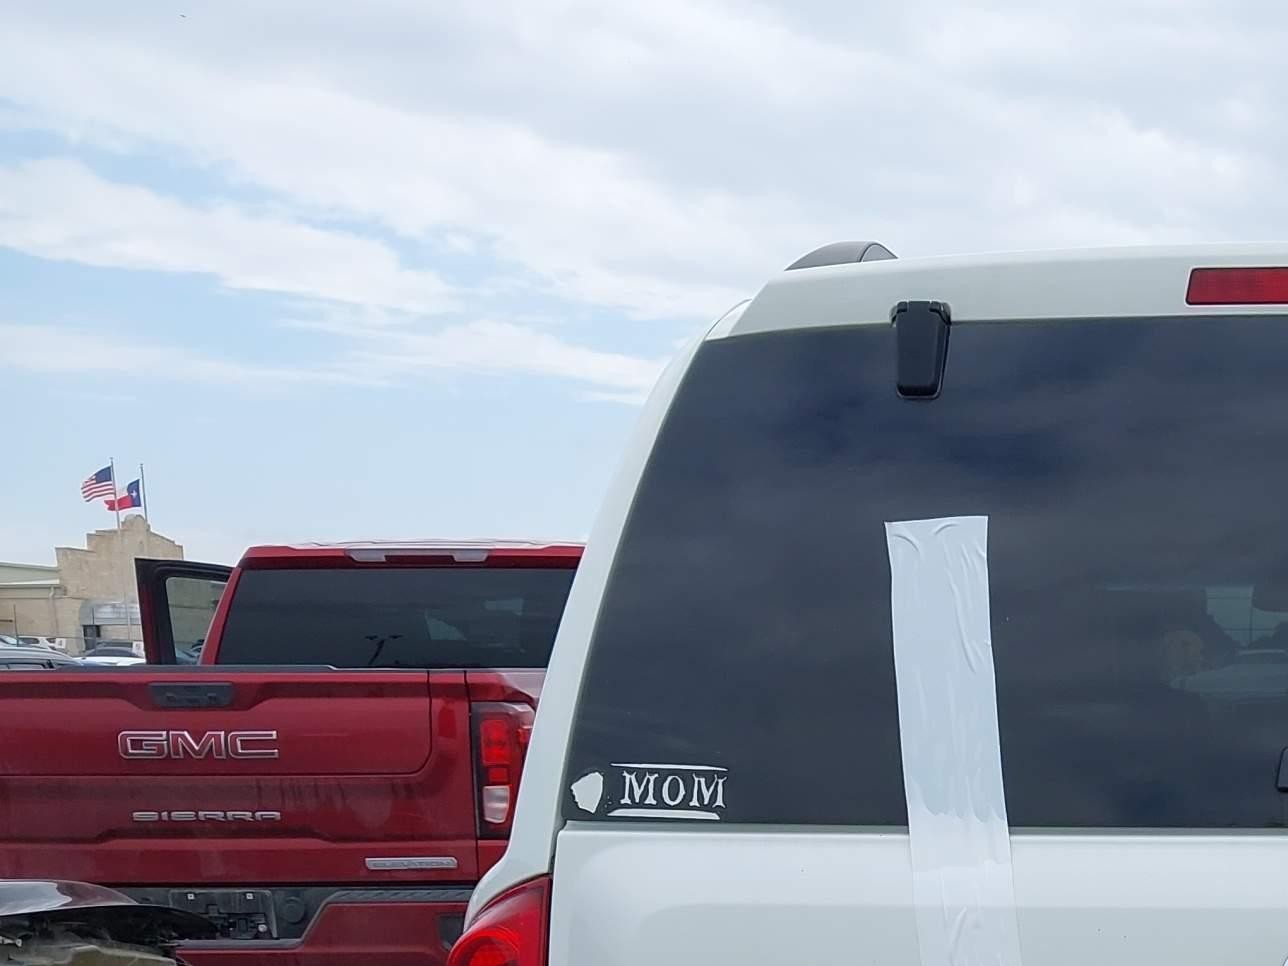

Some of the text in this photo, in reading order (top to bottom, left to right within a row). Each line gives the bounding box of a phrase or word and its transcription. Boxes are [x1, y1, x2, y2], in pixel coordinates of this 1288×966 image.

[117, 729, 280, 760] GMC
[619, 768, 727, 811] MOM
[131, 810, 282, 823] SIERRA
